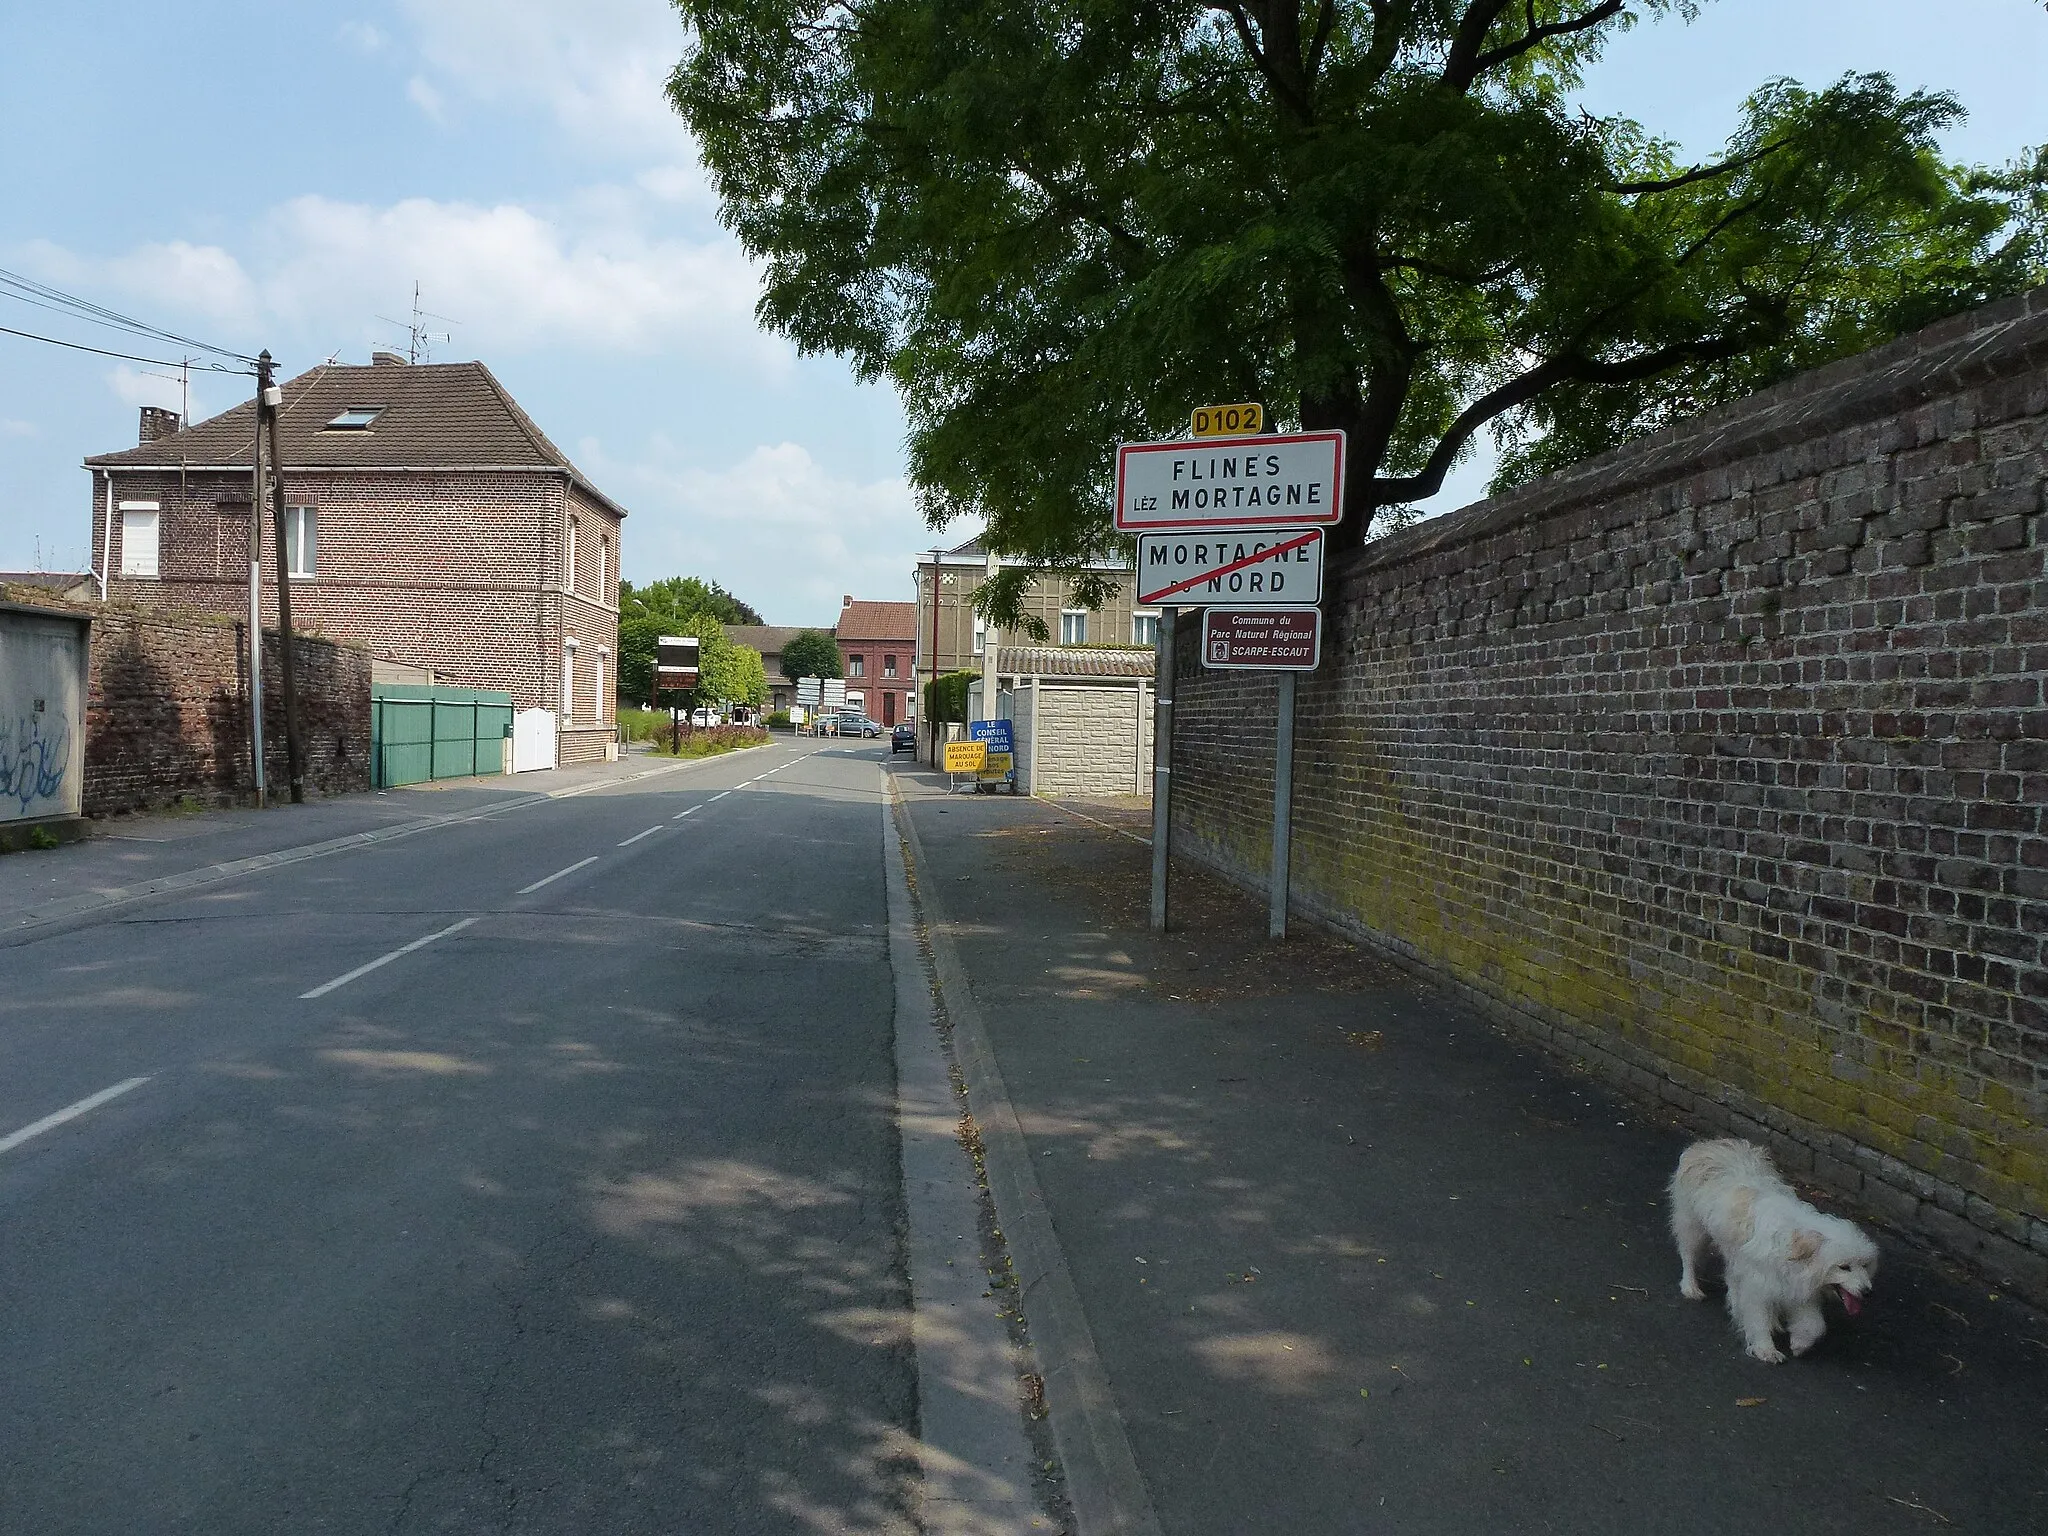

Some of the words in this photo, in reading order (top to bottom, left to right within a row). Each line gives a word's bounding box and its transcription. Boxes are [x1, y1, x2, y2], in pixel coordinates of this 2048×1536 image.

[1196, 408, 1257, 432] D102
[1173, 455, 1280, 481] FLINES
[1172, 483, 1321, 509] MORTAGNE
[1150, 542, 1310, 565] MORTAGNE
[1207, 571, 1285, 593] NORD
[1232, 615, 1274, 625] Commune
[1279, 615, 1291, 625] du
[1210, 629, 1231, 639] Parc
[1235, 629, 1268, 639] Naturel
[1272, 629, 1312, 641] Régional
[1231, 646, 1310, 657] SCARPE-ESCAUT
[976, 728, 1007, 736] CONSEIL
